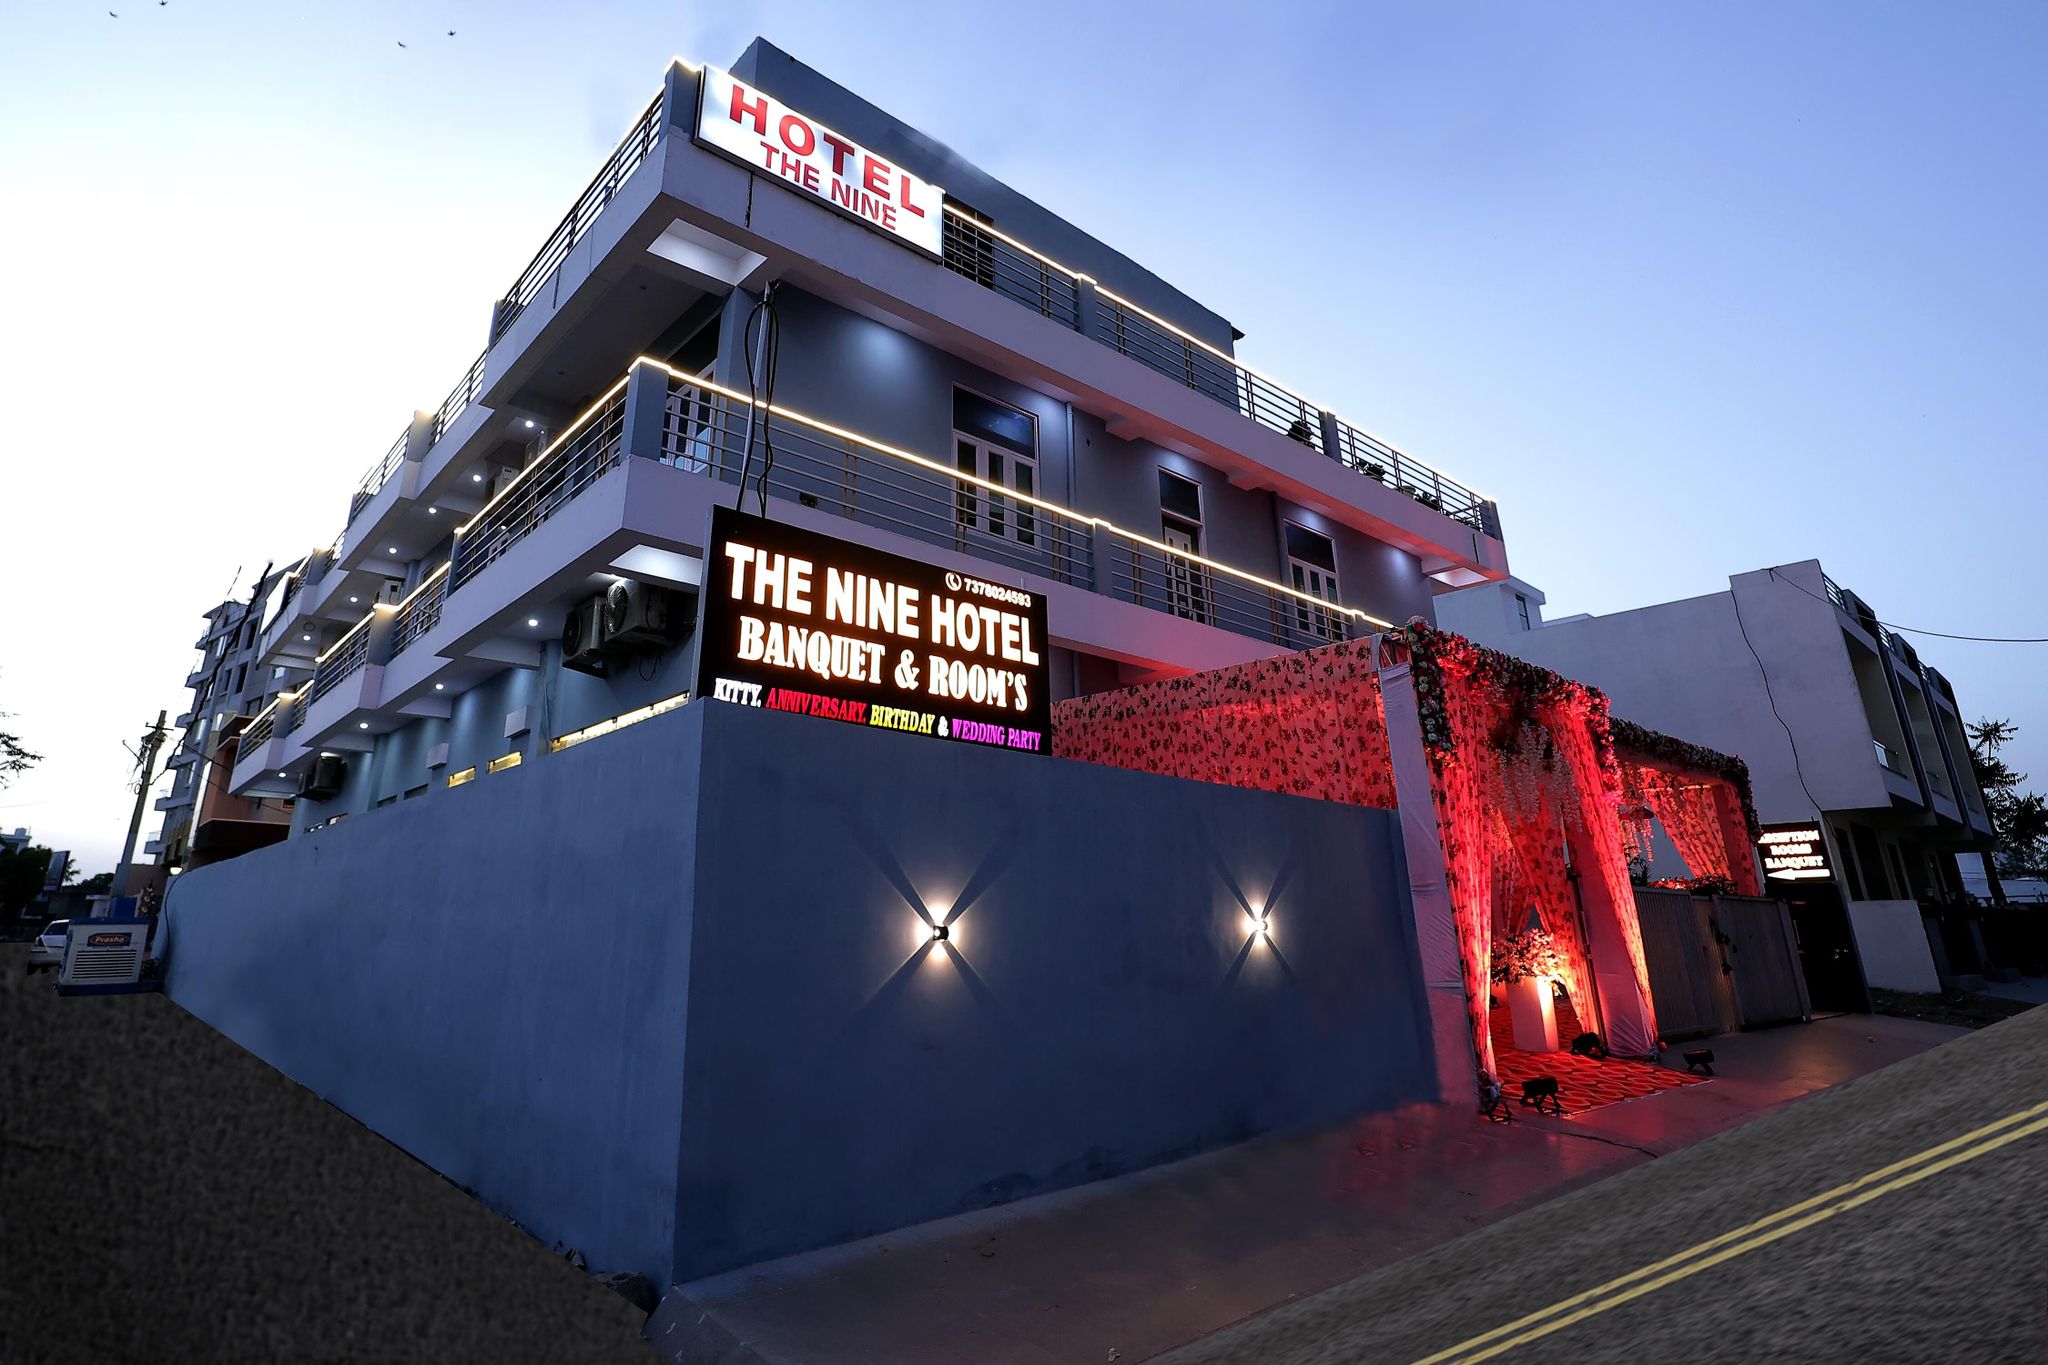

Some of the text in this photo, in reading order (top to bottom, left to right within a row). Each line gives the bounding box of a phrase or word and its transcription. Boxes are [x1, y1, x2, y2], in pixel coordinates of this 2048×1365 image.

[729, 84, 925, 218] HOTEL
[760, 140, 896, 231] THE NINE
[725, 541, 1040, 666] THE NINE HOTEL
[737, 615, 1029, 712] BANQUET & ROOM'S
[869, 704, 936, 735] BIRTHDAY
[937, 716, 949, 738] &
[952, 718, 1006, 746] WEDDING
[1008, 729, 1042, 751] PARTY
[1764, 855, 1824, 870] BANQUET
